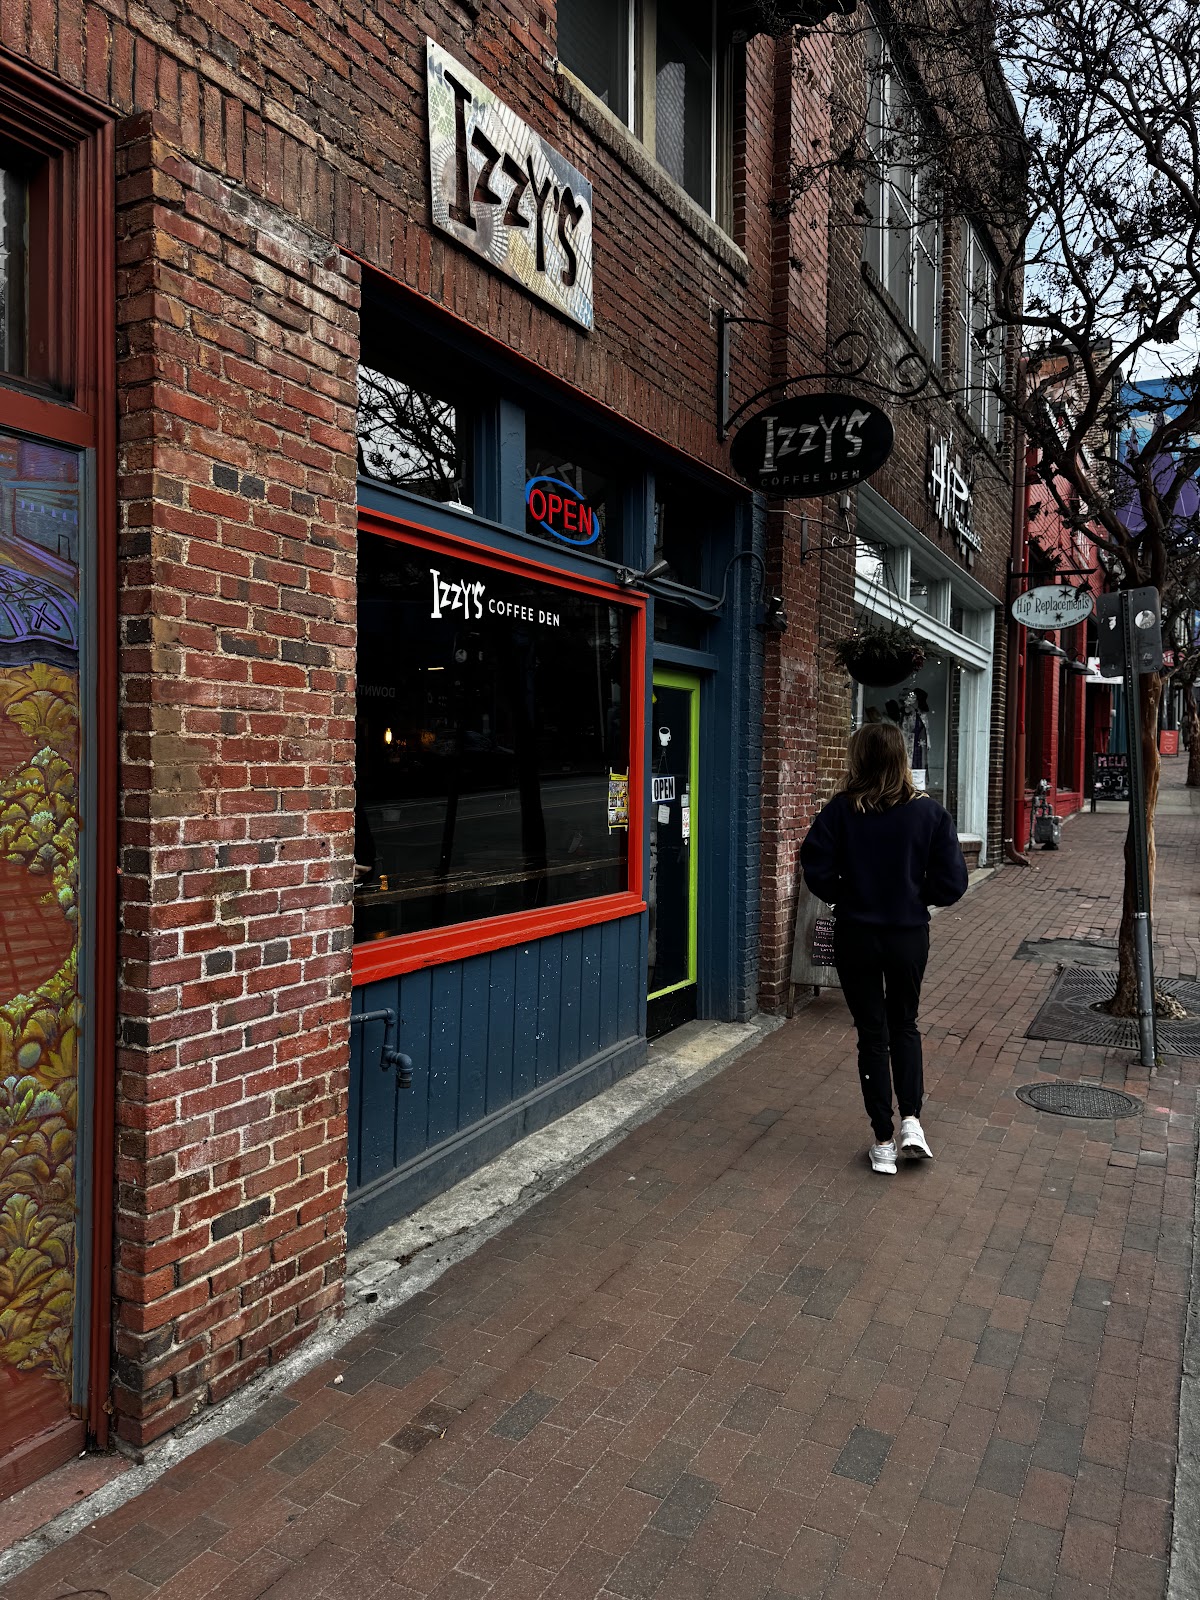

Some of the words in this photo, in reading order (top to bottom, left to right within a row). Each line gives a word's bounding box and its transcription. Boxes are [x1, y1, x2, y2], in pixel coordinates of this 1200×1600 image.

[761, 473, 820, 487] COFFEE
[830, 469, 861, 481] DEN
[529, 488, 592, 536] OPEN
[488, 598, 534, 622] COFFEE
[539, 610, 560, 627] DEN
[1017, 598, 1032, 616] Hip
[1035, 594, 1090, 614] Replacements
[654, 777, 673, 800] OPEN
